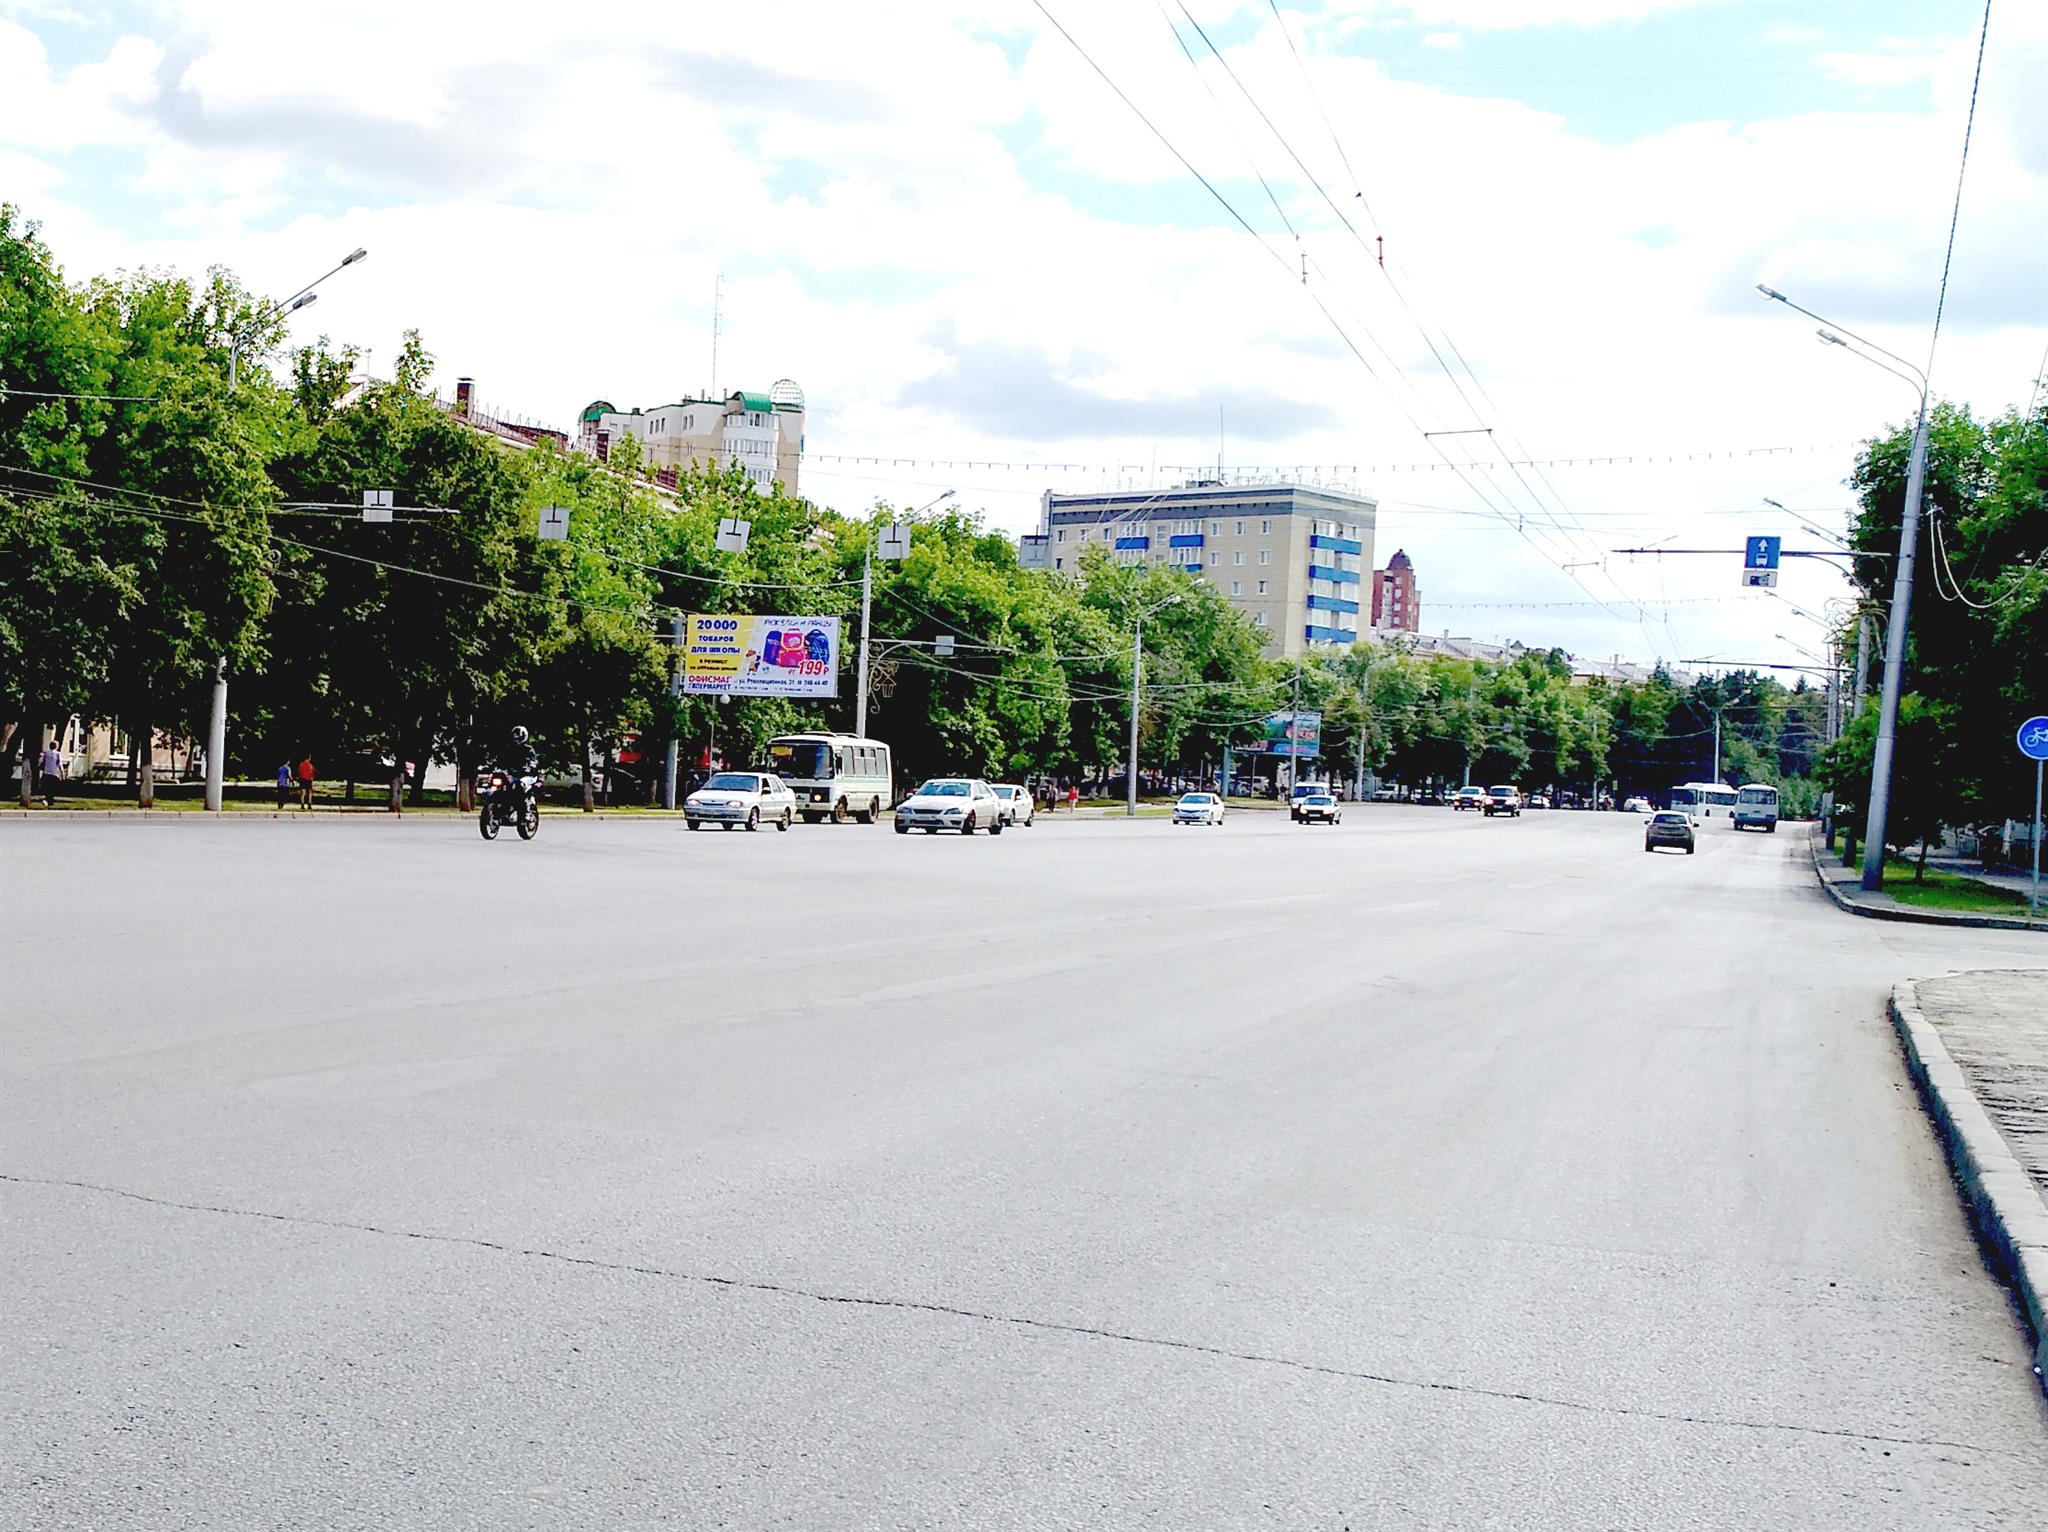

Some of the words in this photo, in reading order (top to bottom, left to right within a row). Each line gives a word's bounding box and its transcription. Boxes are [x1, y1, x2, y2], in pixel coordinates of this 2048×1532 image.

[709, 646, 741, 654] ШКОЛЫ
[799, 660, 822, 675] 199
[688, 675, 732, 684] ОФИСМАГ
